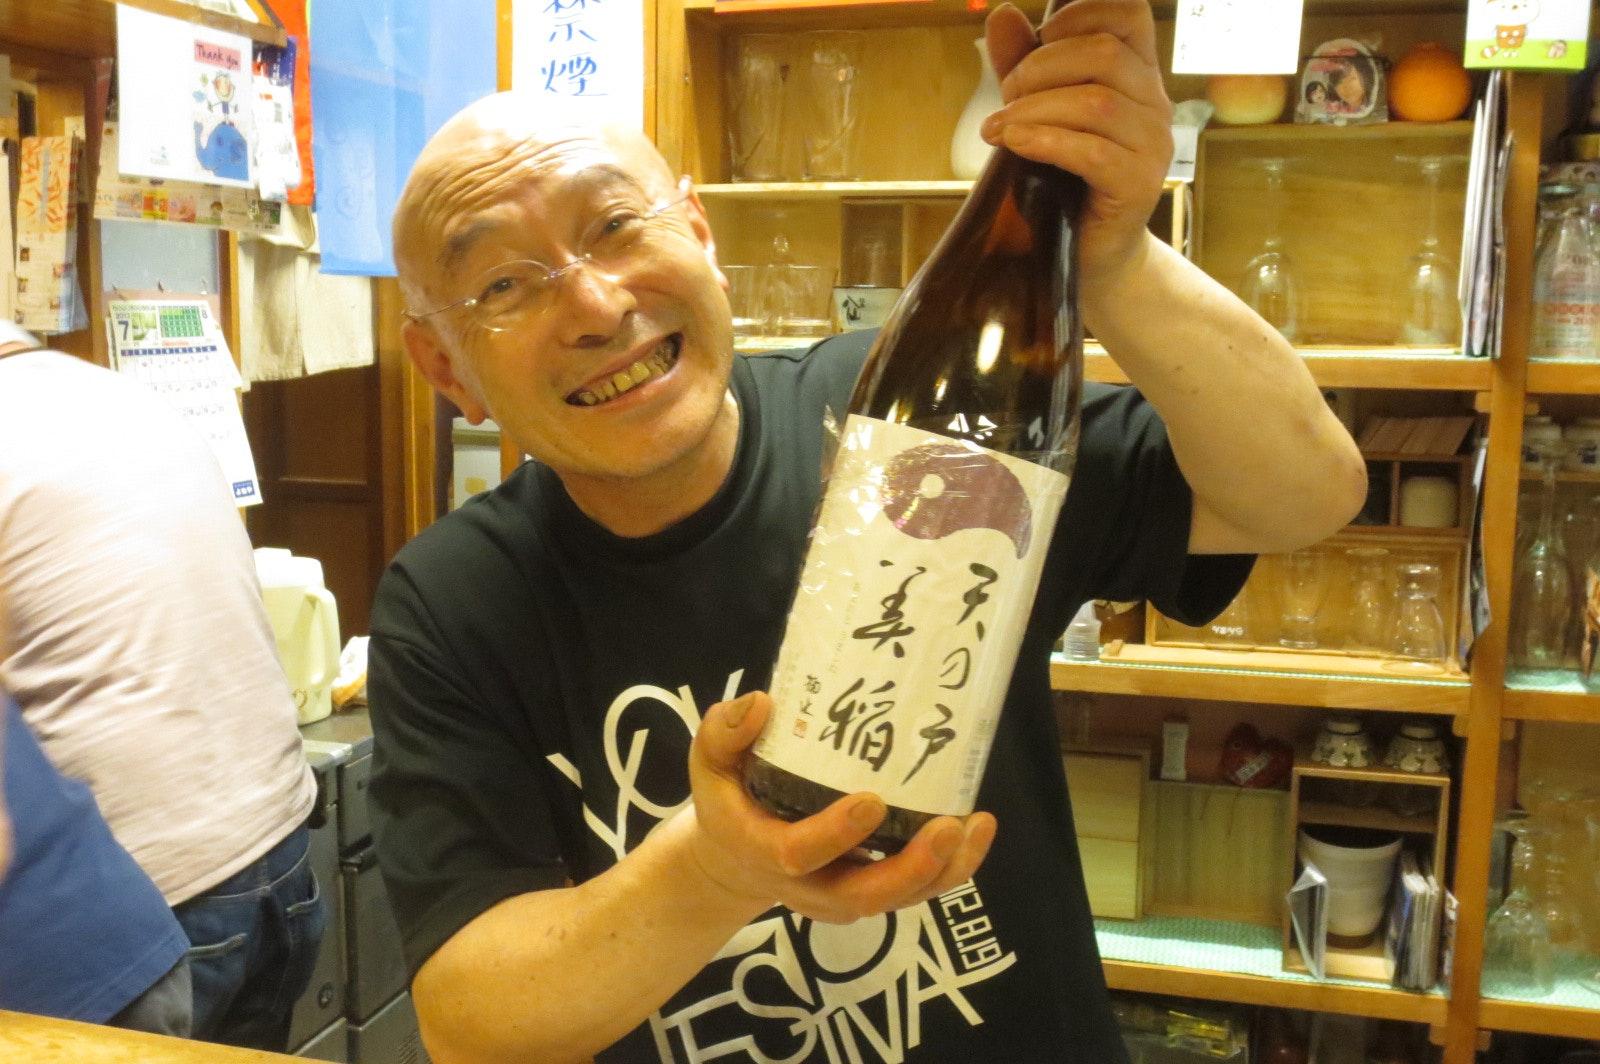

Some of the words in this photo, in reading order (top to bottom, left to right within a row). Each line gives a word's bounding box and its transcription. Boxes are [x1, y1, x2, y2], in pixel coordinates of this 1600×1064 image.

[196, 43, 224, 60] Thank
[226, 54, 239, 70] you
[118, 320, 129, 341] 7
